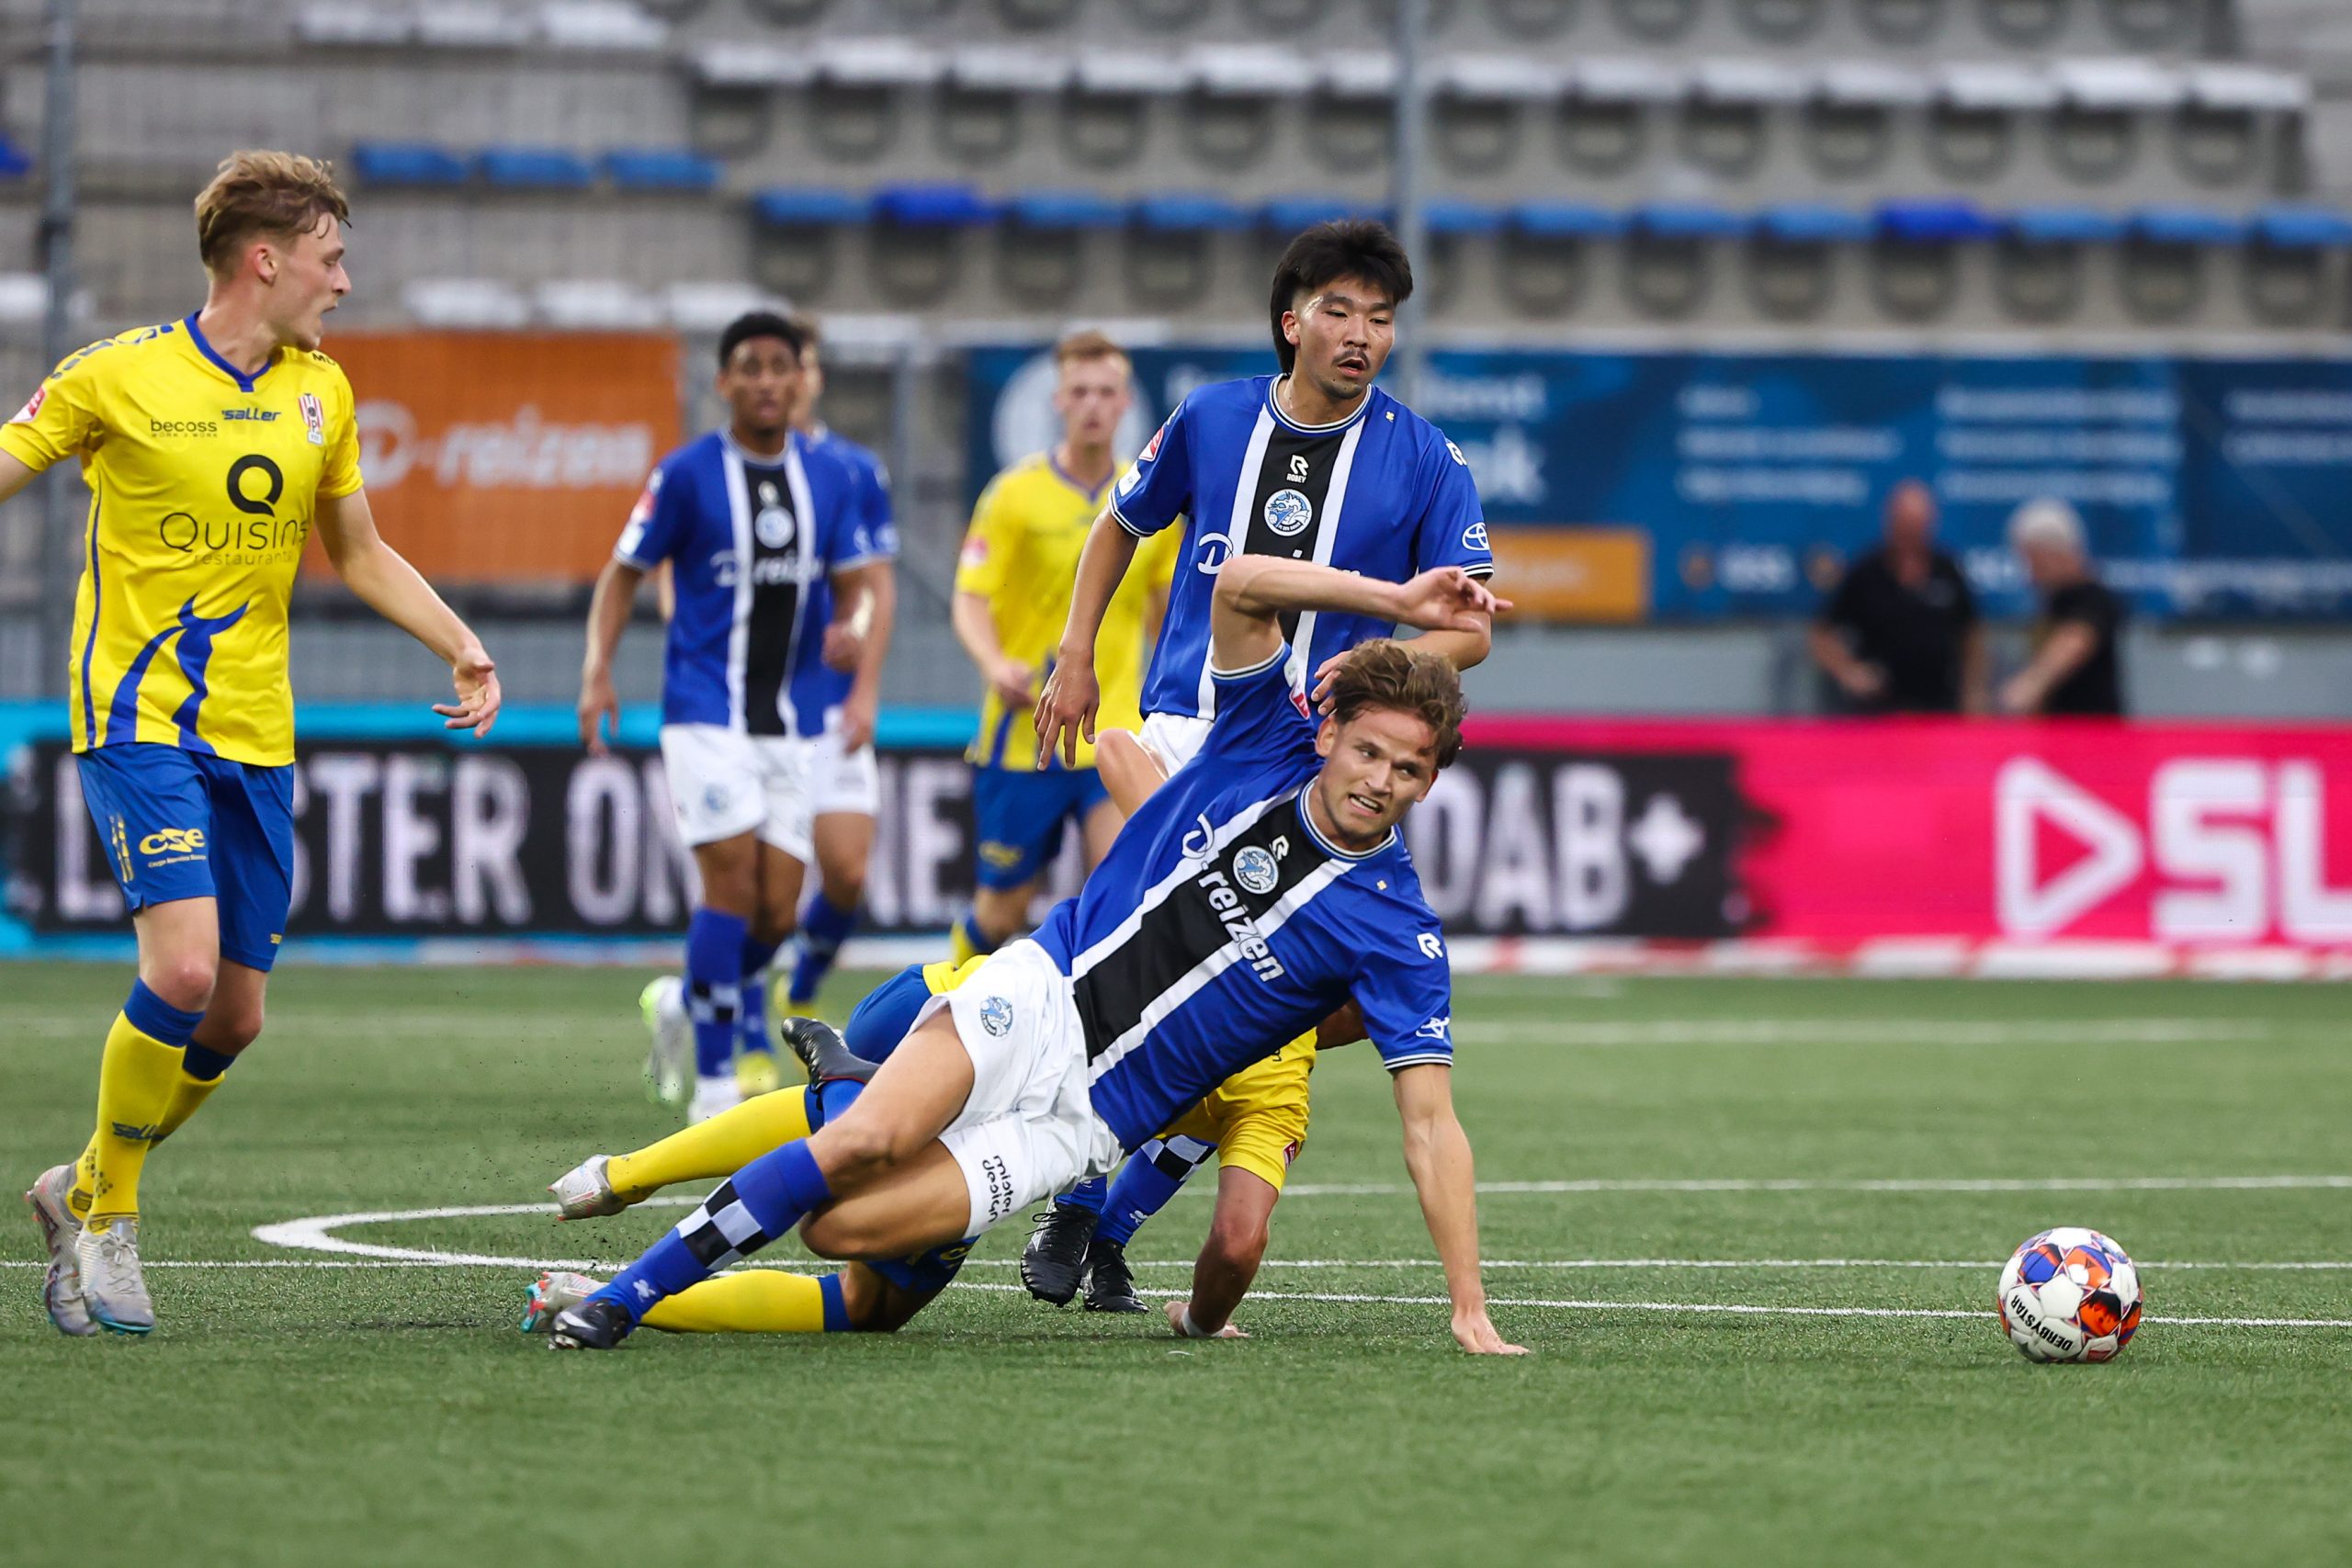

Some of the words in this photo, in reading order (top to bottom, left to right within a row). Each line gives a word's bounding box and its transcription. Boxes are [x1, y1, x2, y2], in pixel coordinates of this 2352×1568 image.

[221, 407, 282, 423] saller
[151, 419, 218, 433] becoss
[1286, 473, 1306, 484] ROBEY
[55, 753, 535, 924] LTER
[2010, 1294, 2074, 1351] DERBYSTAR
